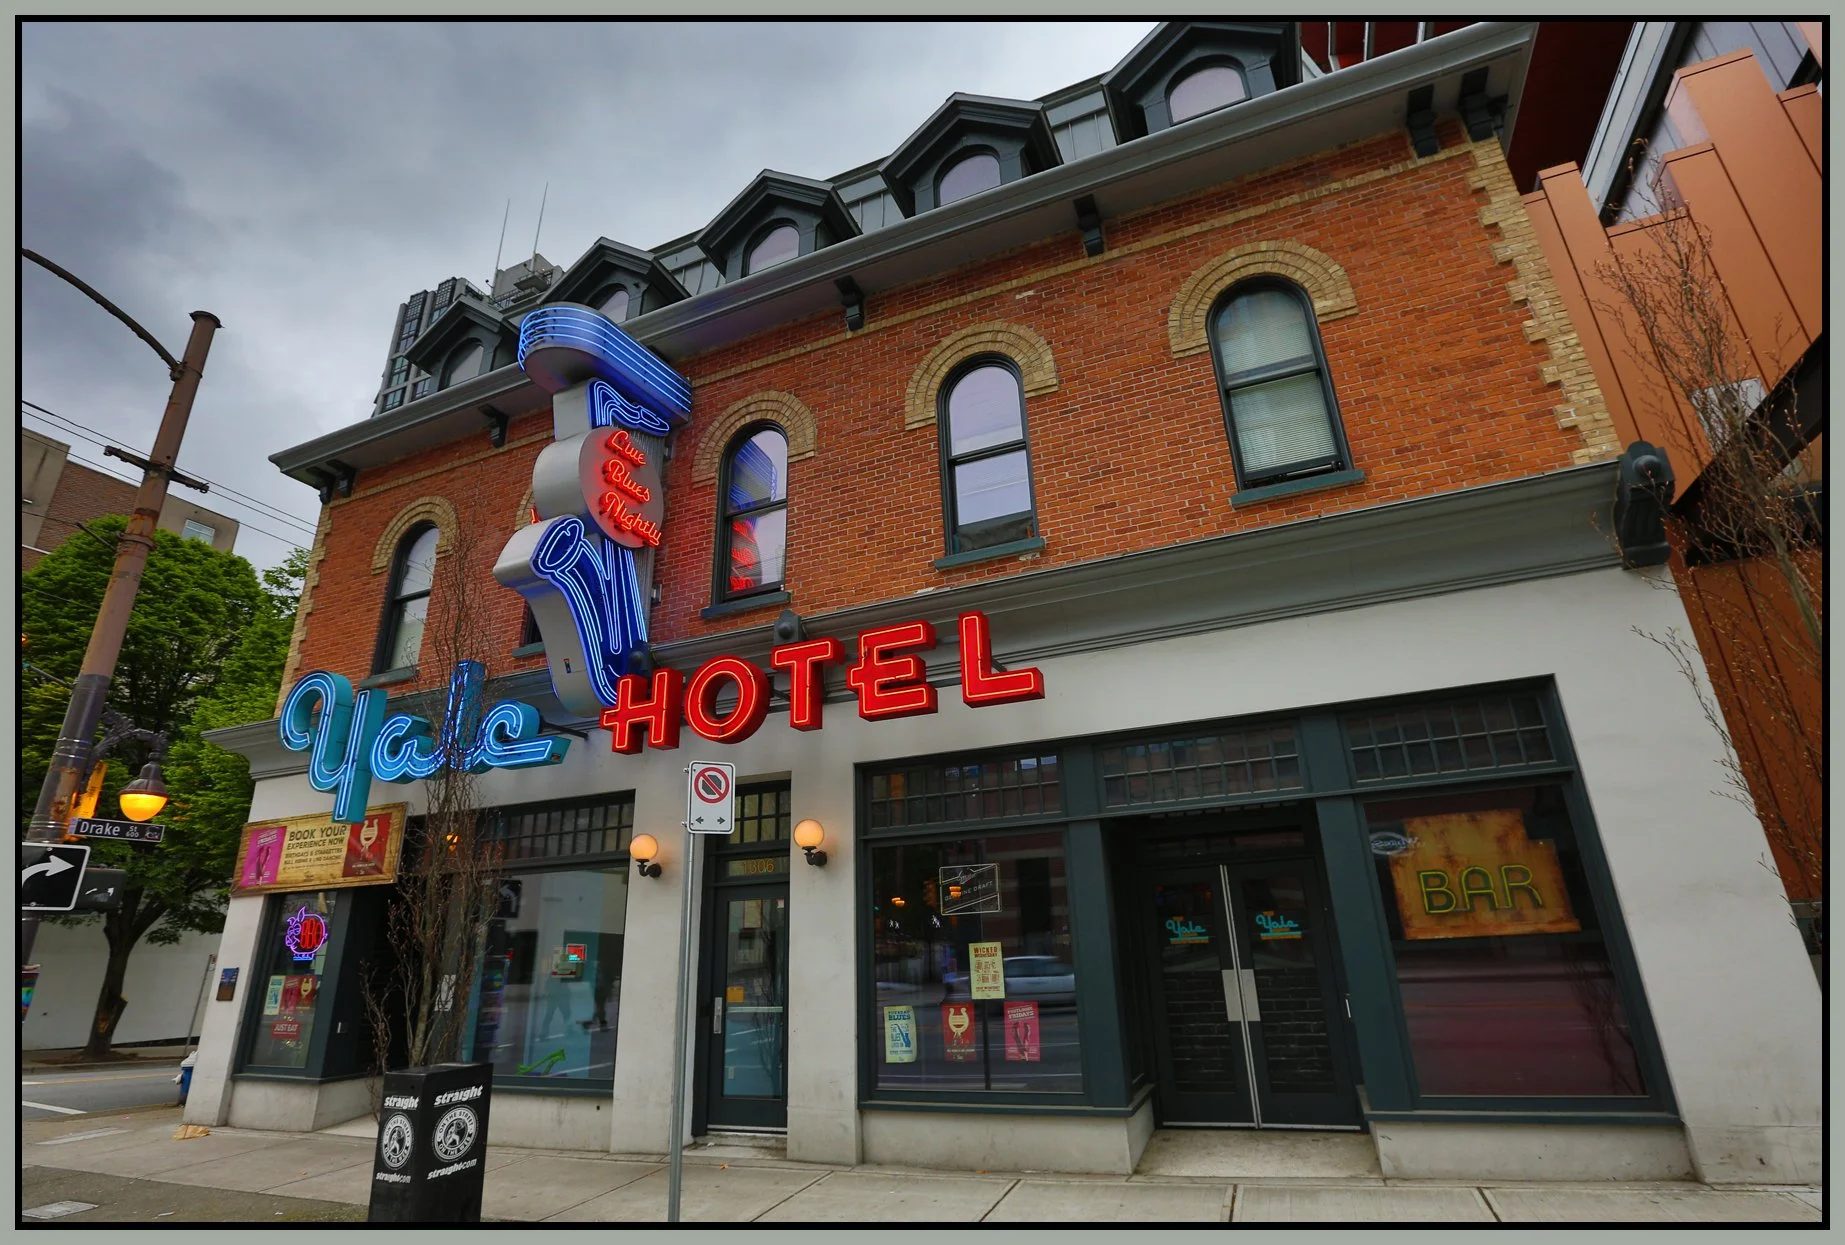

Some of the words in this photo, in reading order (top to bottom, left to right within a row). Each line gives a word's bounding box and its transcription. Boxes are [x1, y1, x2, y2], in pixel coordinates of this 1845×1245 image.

[606, 430, 646, 467] Live
[603, 459, 651, 504] Blues
[600, 491, 662, 546] Nightly
[600, 611, 1046, 755] HOTEL
[279, 660, 571, 823] Yale
[79, 821, 121, 836] Drake
[288, 828, 316, 841] BOOK
[319, 825, 348, 838] YOUR
[286, 839, 327, 850] EXPERIENCE
[327, 837, 345, 846] NOW
[972, 880, 993, 892] DRAFT
[1417, 864, 1543, 914] BAR
[1165, 919, 1207, 939] Yale
[1256, 914, 1299, 933] Yale
[974, 946, 998, 954] WICKED
[1008, 1011, 1034, 1020] FRIDAYS
[274, 1023, 287, 1032] JUST
[287, 1023, 299, 1032] EAT
[384, 1096, 420, 1110] straight
[434, 1085, 483, 1105] straight
